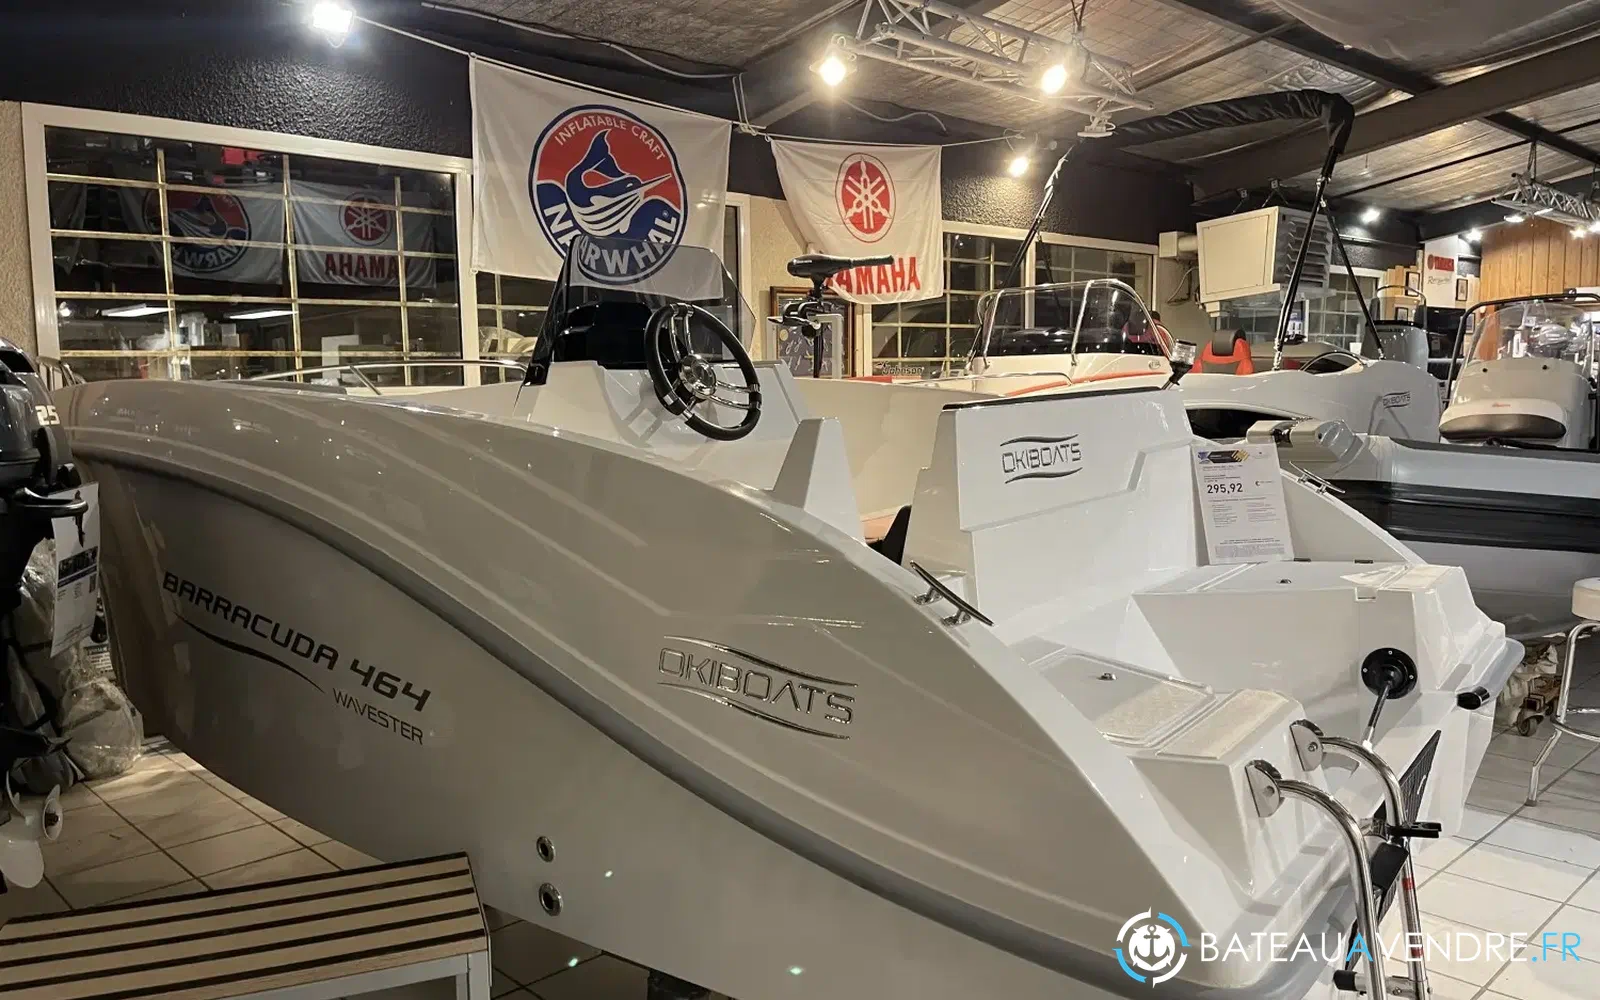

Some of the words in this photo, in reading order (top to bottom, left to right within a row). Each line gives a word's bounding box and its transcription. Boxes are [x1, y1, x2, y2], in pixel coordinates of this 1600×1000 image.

[555, 115, 627, 145] INFLATABLE
[631, 125, 666, 161] CRAFT
[544, 203, 677, 275] NARWHAL
[825, 257, 921, 295] AMAHA
[35, 405, 61, 426] 25
[1002, 443, 1082, 473] OKIBOATS
[1206, 482, 1244, 494] 295,92
[162, 571, 339, 670] BARRACUDA
[350, 658, 431, 712] 464
[659, 647, 856, 724] OKIBOATS
[332, 688, 424, 745] WAVESTER
